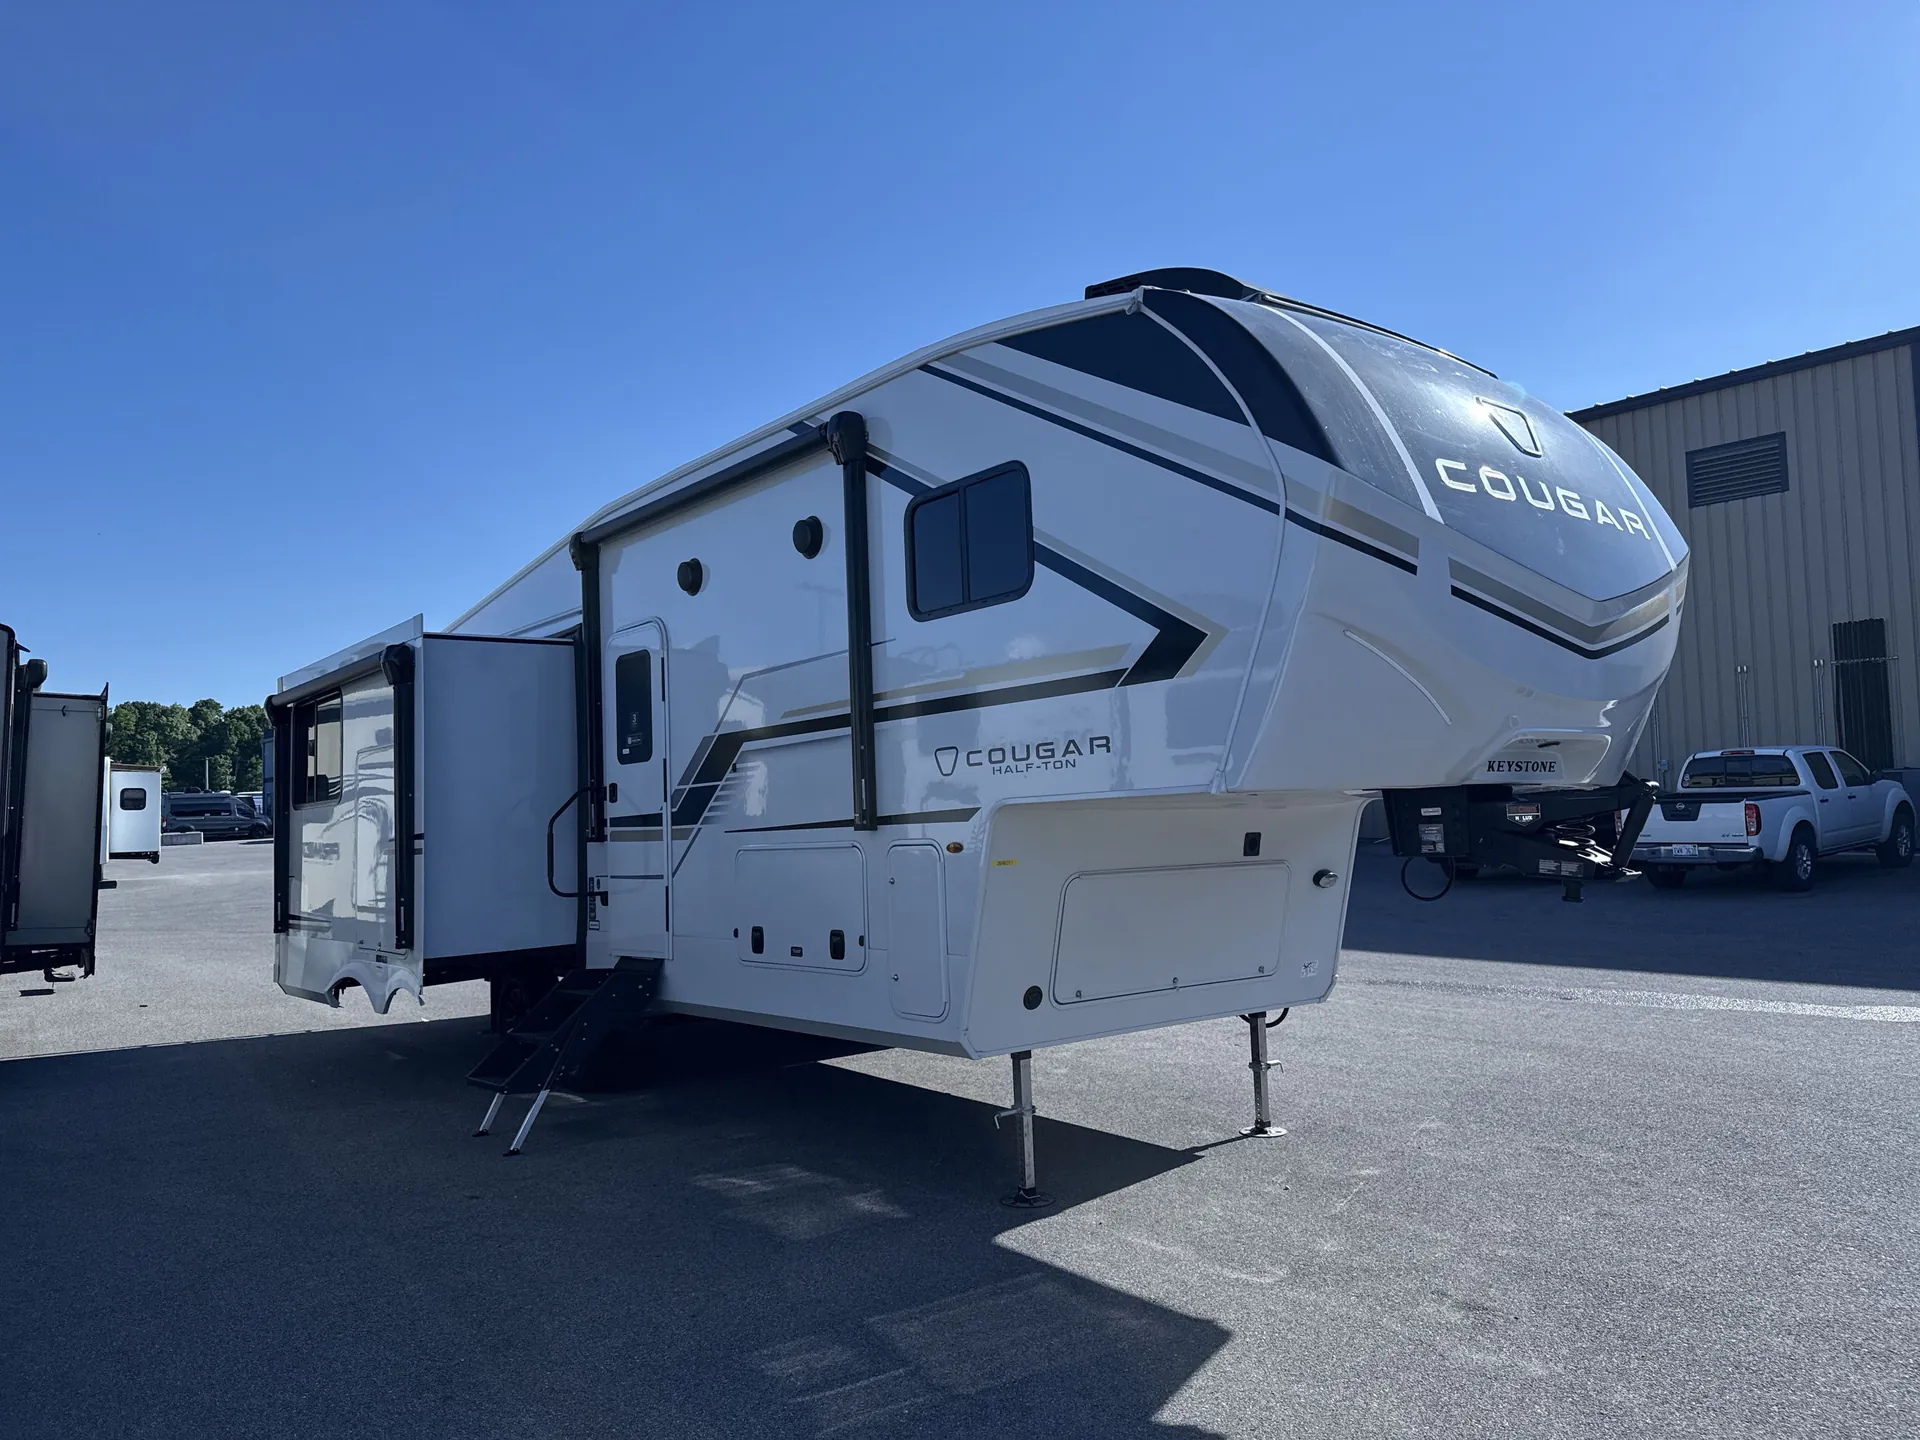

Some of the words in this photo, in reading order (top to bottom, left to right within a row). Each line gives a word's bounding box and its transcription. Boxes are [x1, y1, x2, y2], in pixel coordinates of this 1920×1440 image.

[1435, 457, 1651, 541] COUGAR
[966, 735, 1111, 767] COUGAR
[992, 759, 1077, 775] HALF-TON
[1486, 760, 1557, 773] KEYSTONE
